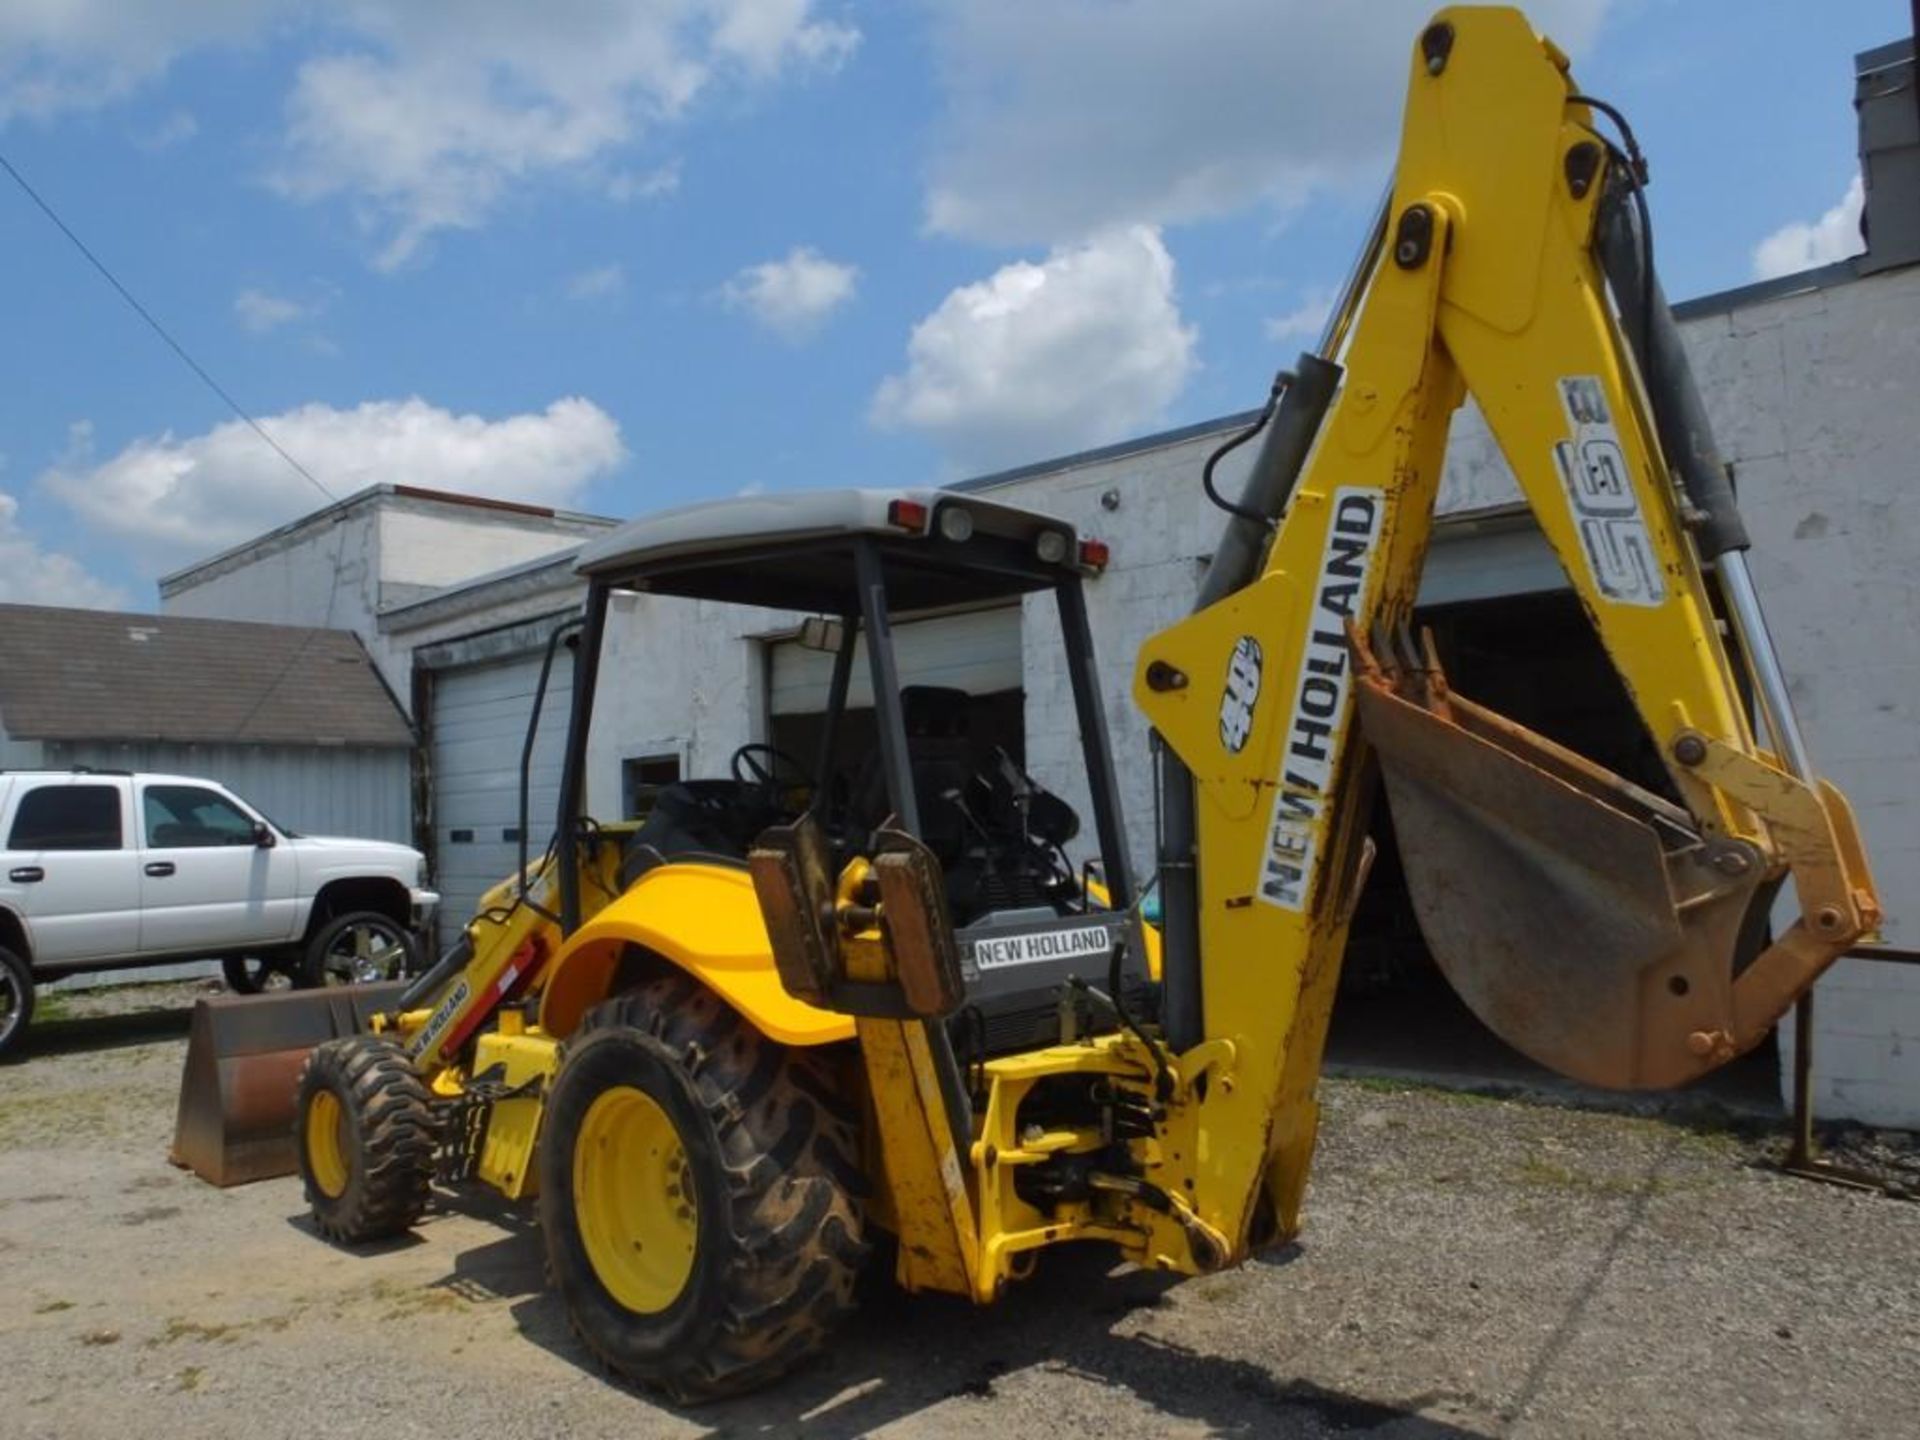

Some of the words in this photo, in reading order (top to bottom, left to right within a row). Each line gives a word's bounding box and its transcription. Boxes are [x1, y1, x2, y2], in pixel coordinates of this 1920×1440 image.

[1290, 495, 1375, 761] HOLLAND
[1263, 770, 1320, 903] NEW
[978, 939, 1022, 965] NEW
[1027, 928, 1106, 958] HOLLAND
[431, 983, 467, 1034] HOLLAND
